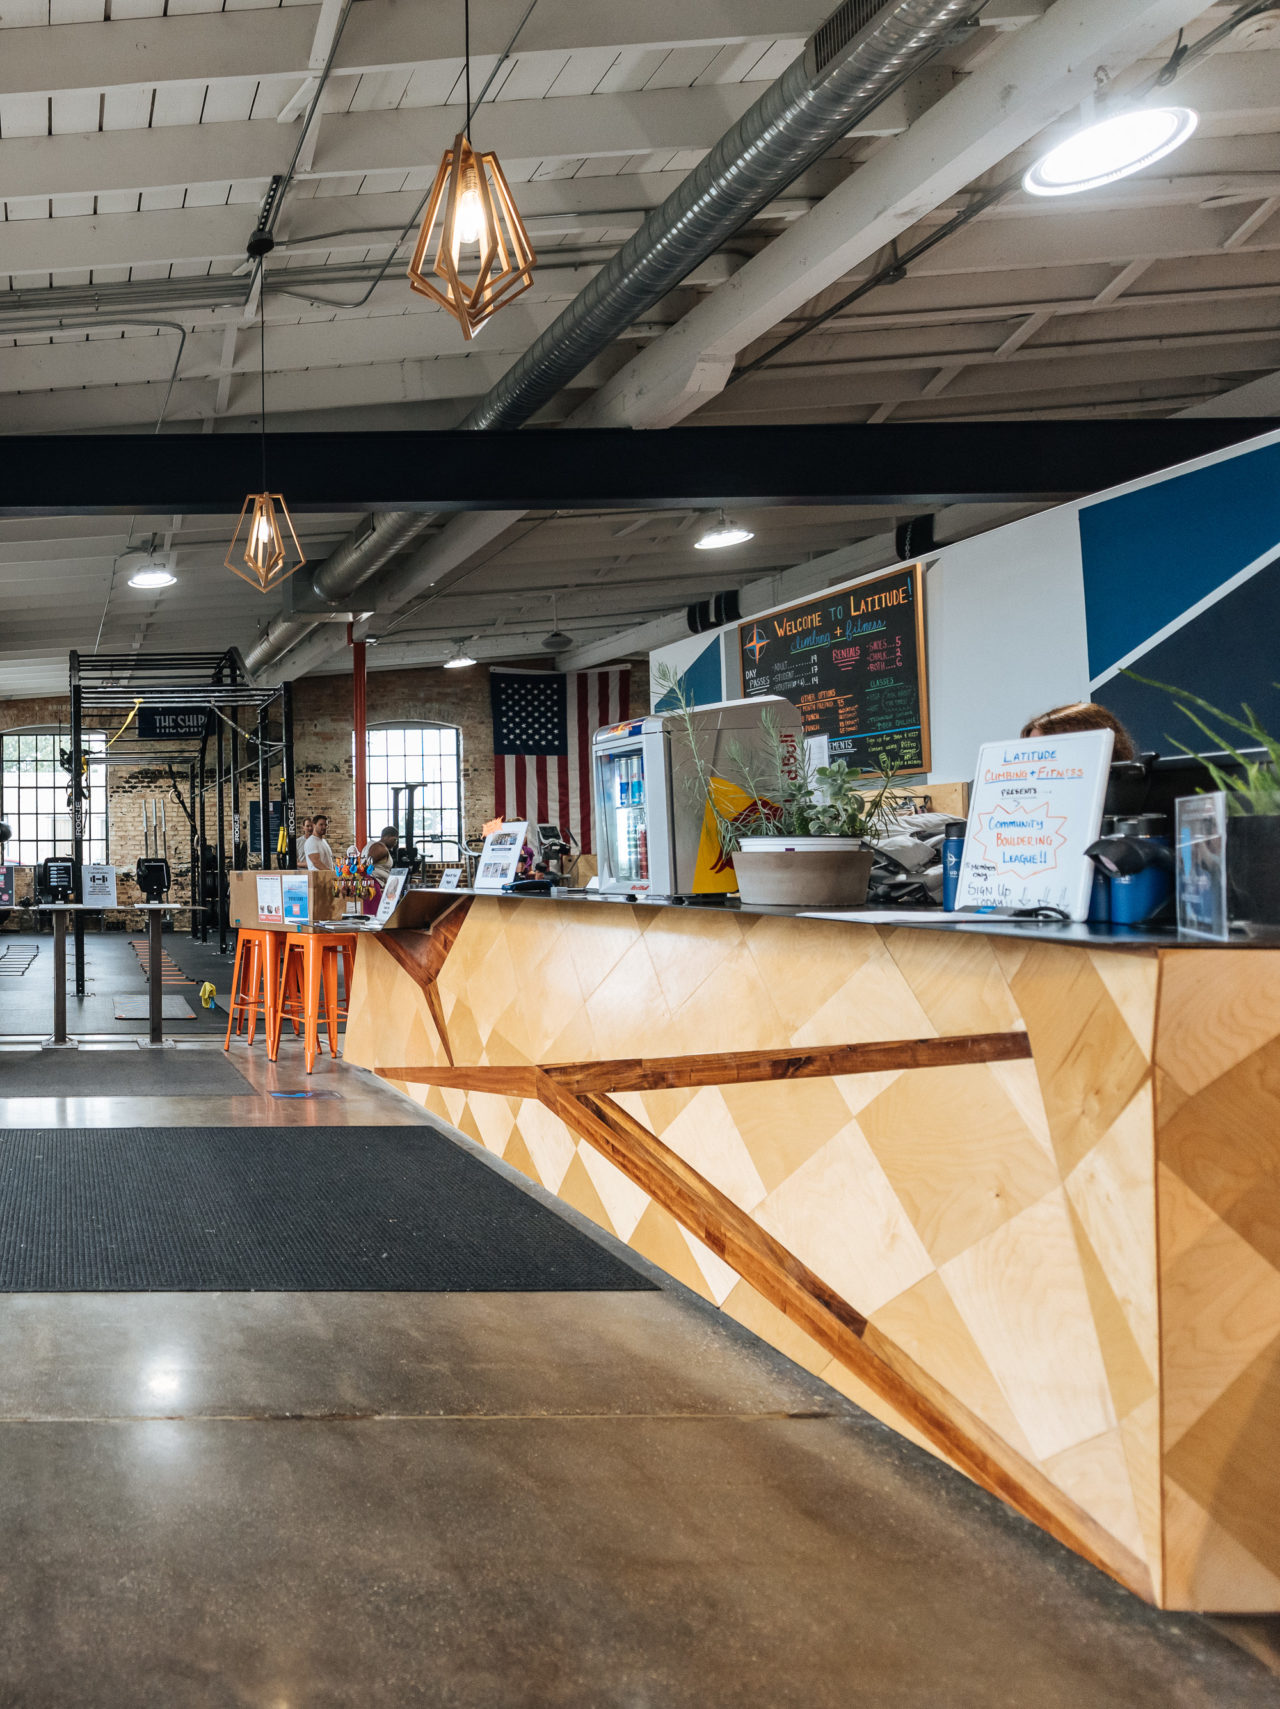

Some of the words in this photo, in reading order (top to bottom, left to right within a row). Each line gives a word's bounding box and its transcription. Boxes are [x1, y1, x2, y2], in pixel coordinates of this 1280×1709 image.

[774, 611, 822, 638] WELCOME
[829, 605, 843, 621] TO
[745, 669, 757, 680] DAY
[749, 676, 770, 688] PASSES
[155, 715, 176, 733] THE
[1003, 750, 1057, 763] LATITUDE
[984, 768, 1028, 782] CLIMBING
[996, 832, 1053, 848] BOULDERING
